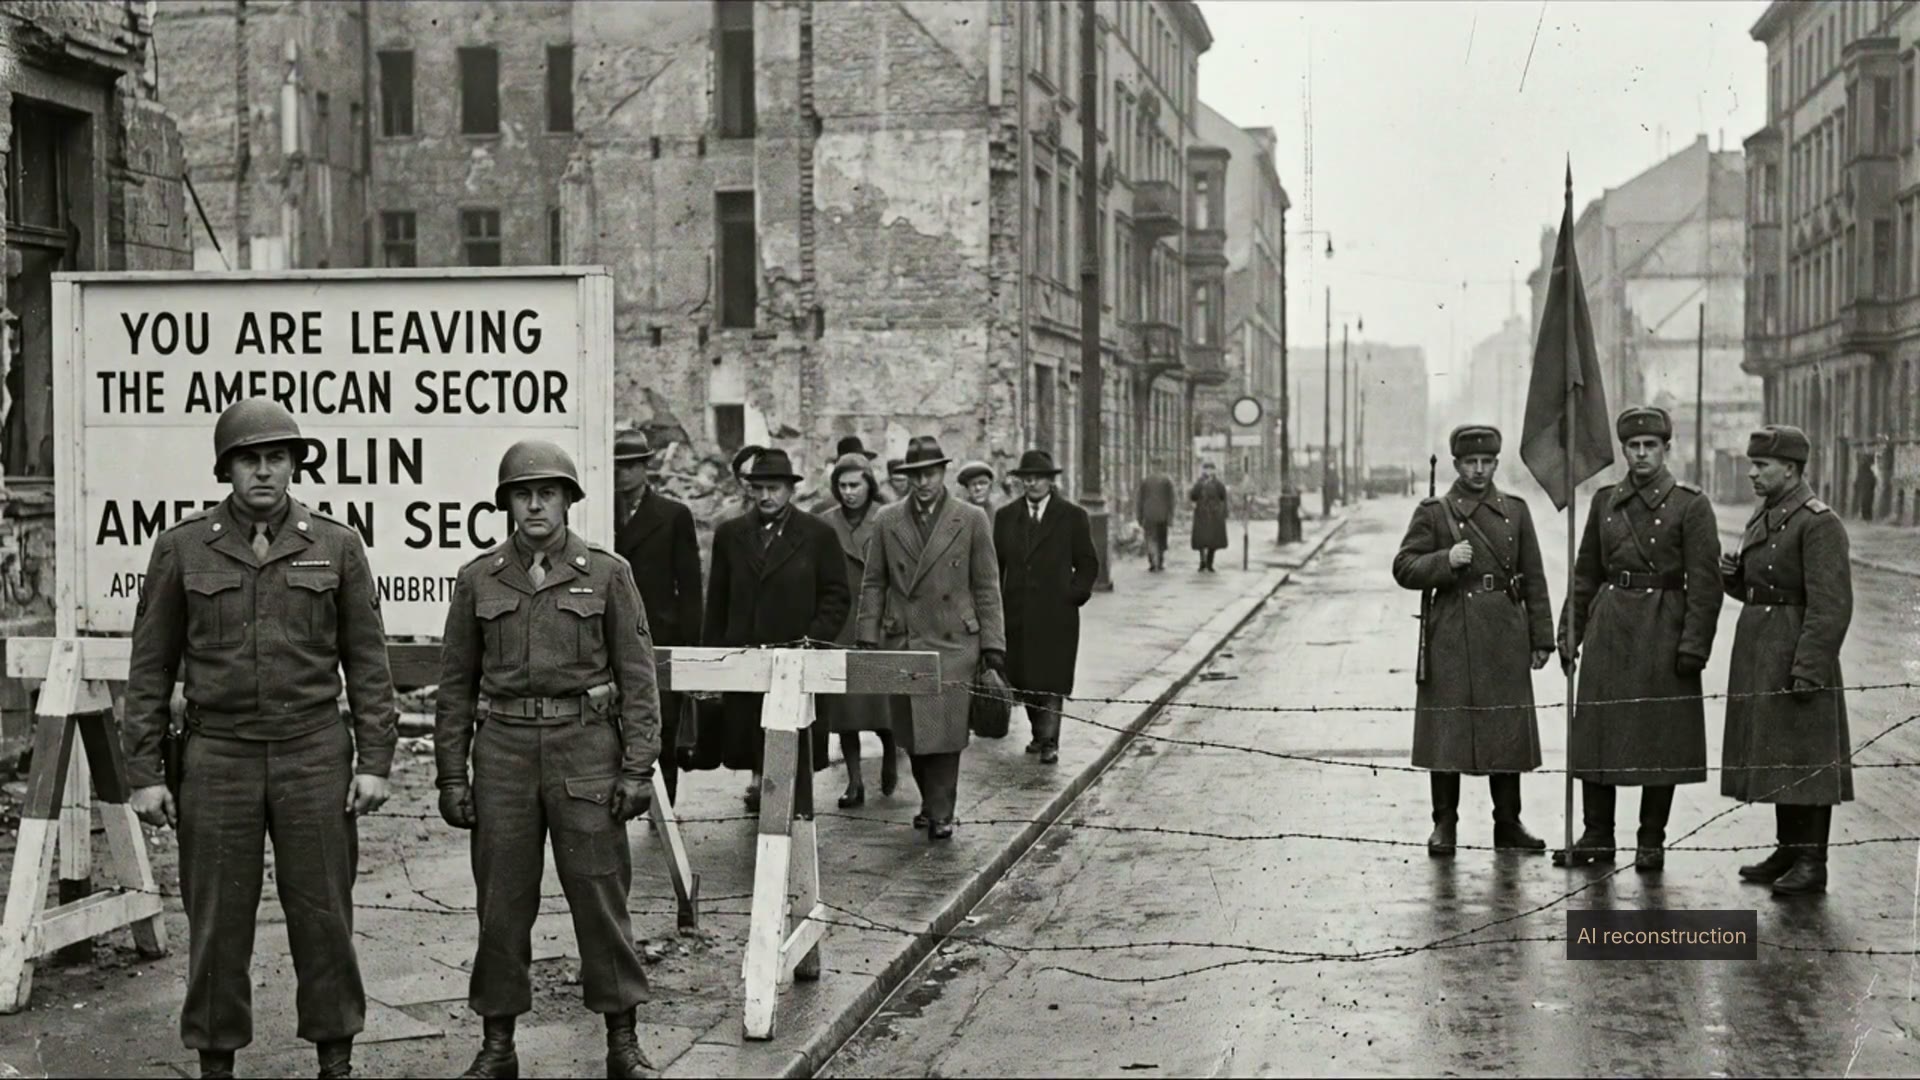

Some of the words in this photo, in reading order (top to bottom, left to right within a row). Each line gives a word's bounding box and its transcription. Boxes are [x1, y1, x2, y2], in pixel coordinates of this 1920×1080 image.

[121, 311, 209, 355] YOU
[235, 311, 322, 354] ARE
[351, 309, 542, 354] LEAVING
[97, 371, 165, 413] THE
[185, 370, 391, 414] AMERICAN
[415, 370, 568, 414] SECTOR
[217, 438, 423, 485] RLIN
[404, 501, 516, 549] SEC
